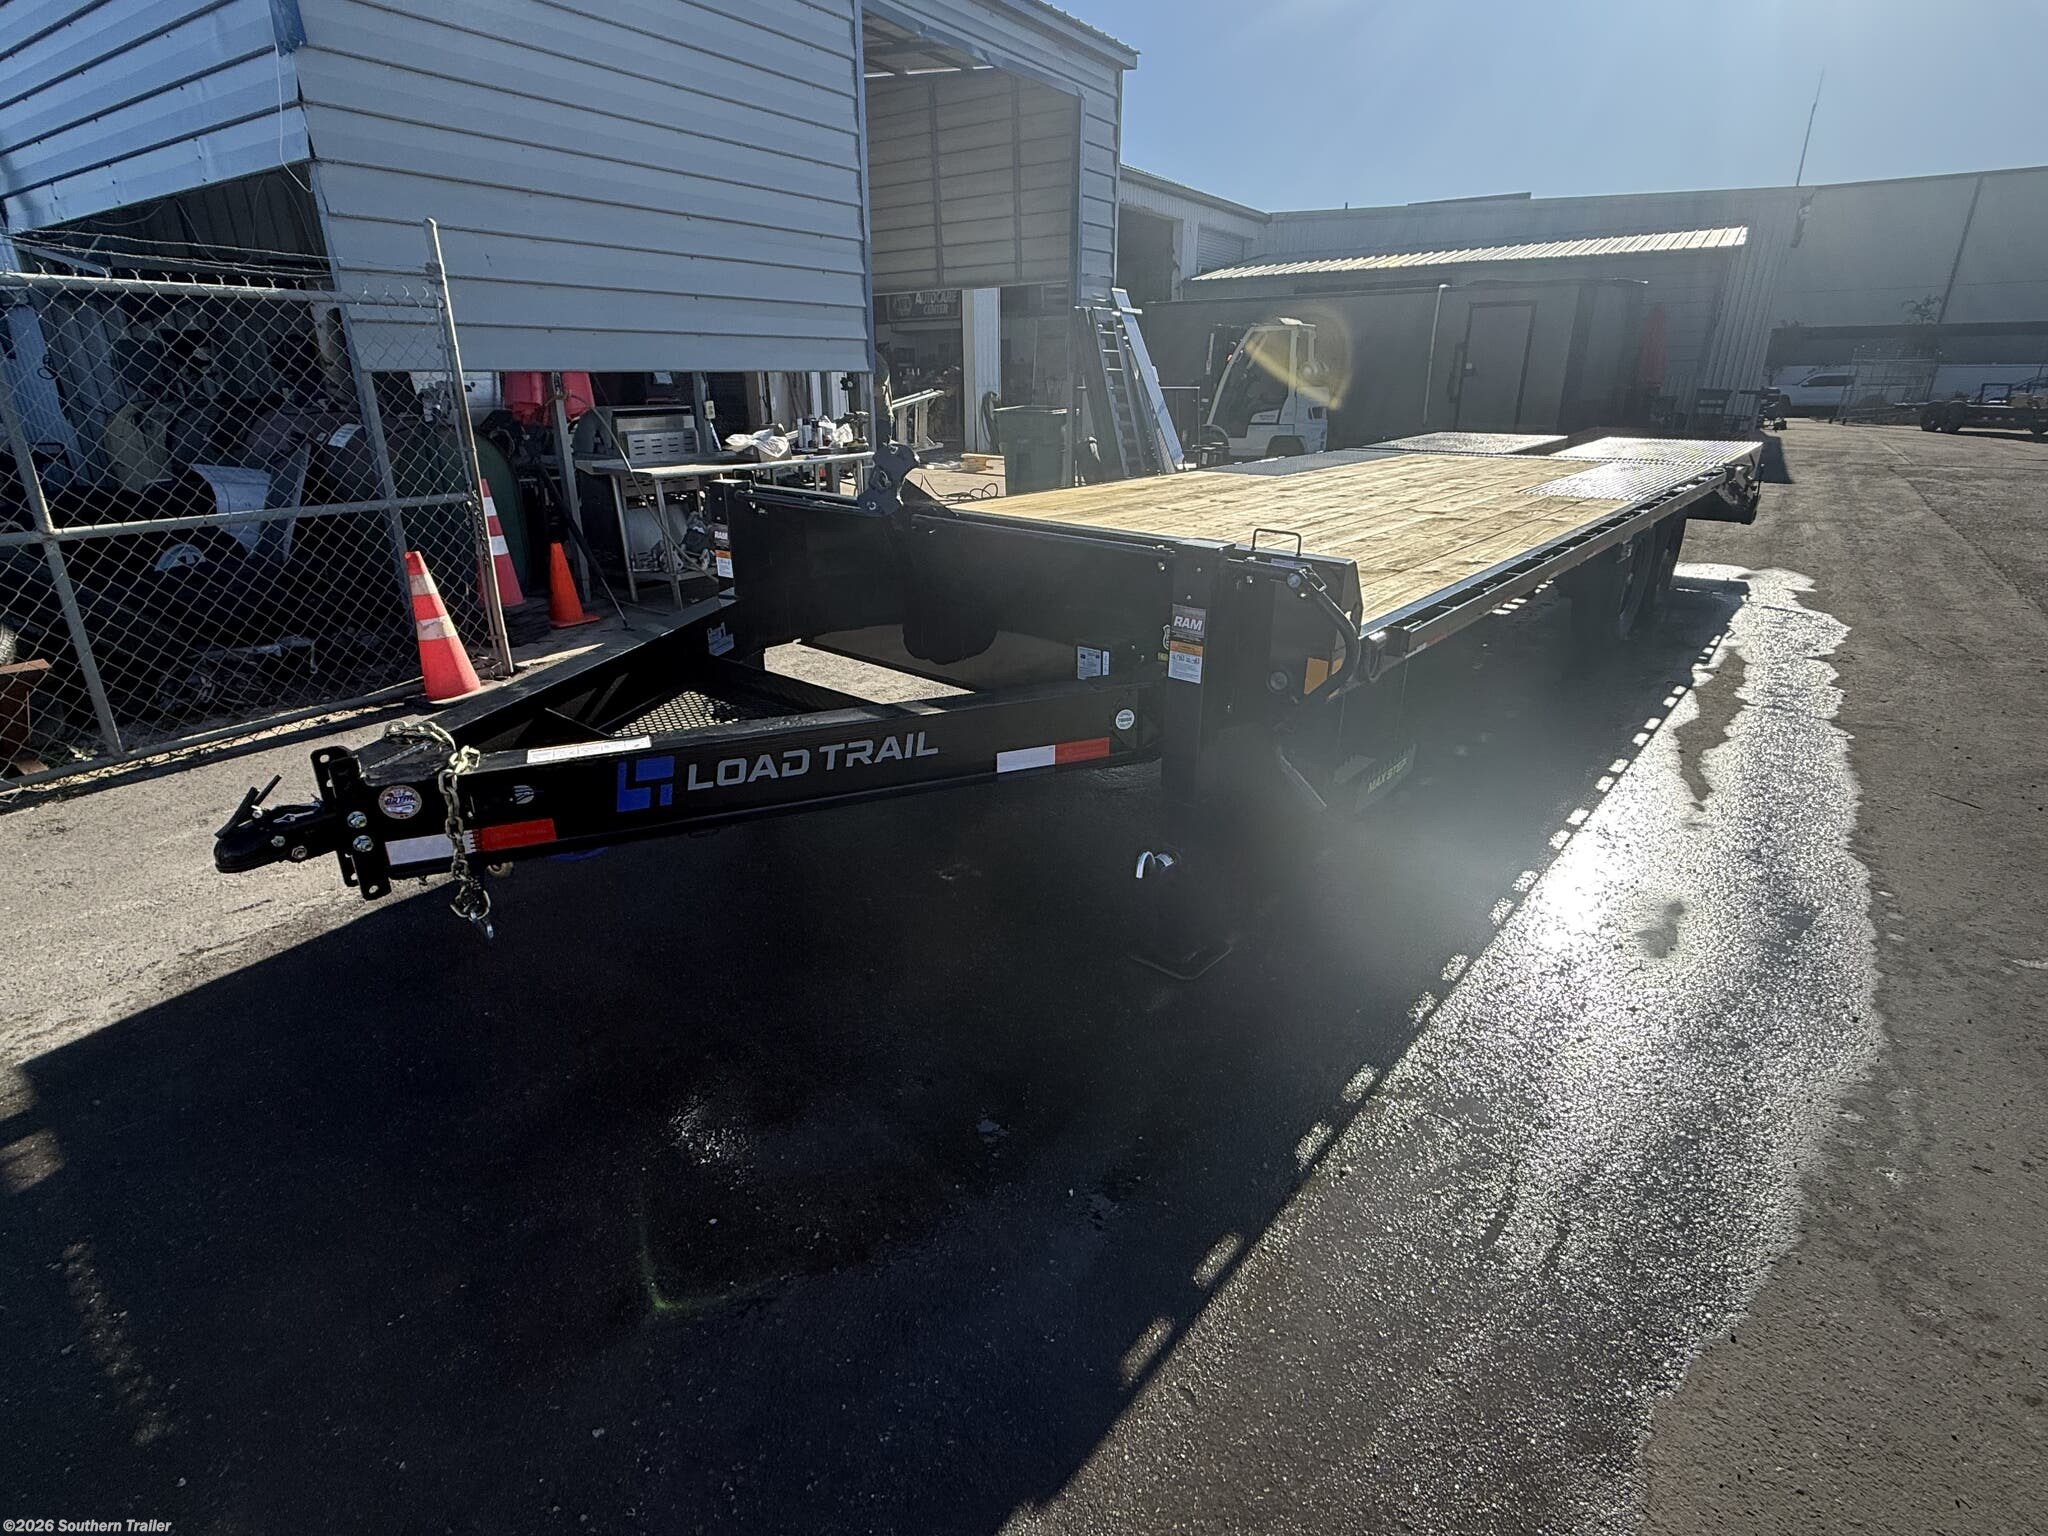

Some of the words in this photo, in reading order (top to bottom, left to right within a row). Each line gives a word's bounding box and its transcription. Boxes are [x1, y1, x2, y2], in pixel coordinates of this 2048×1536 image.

[1173, 615, 1203, 631] RAM
[687, 749, 810, 791] LOAD
[819, 731, 939, 771] TRAIL
